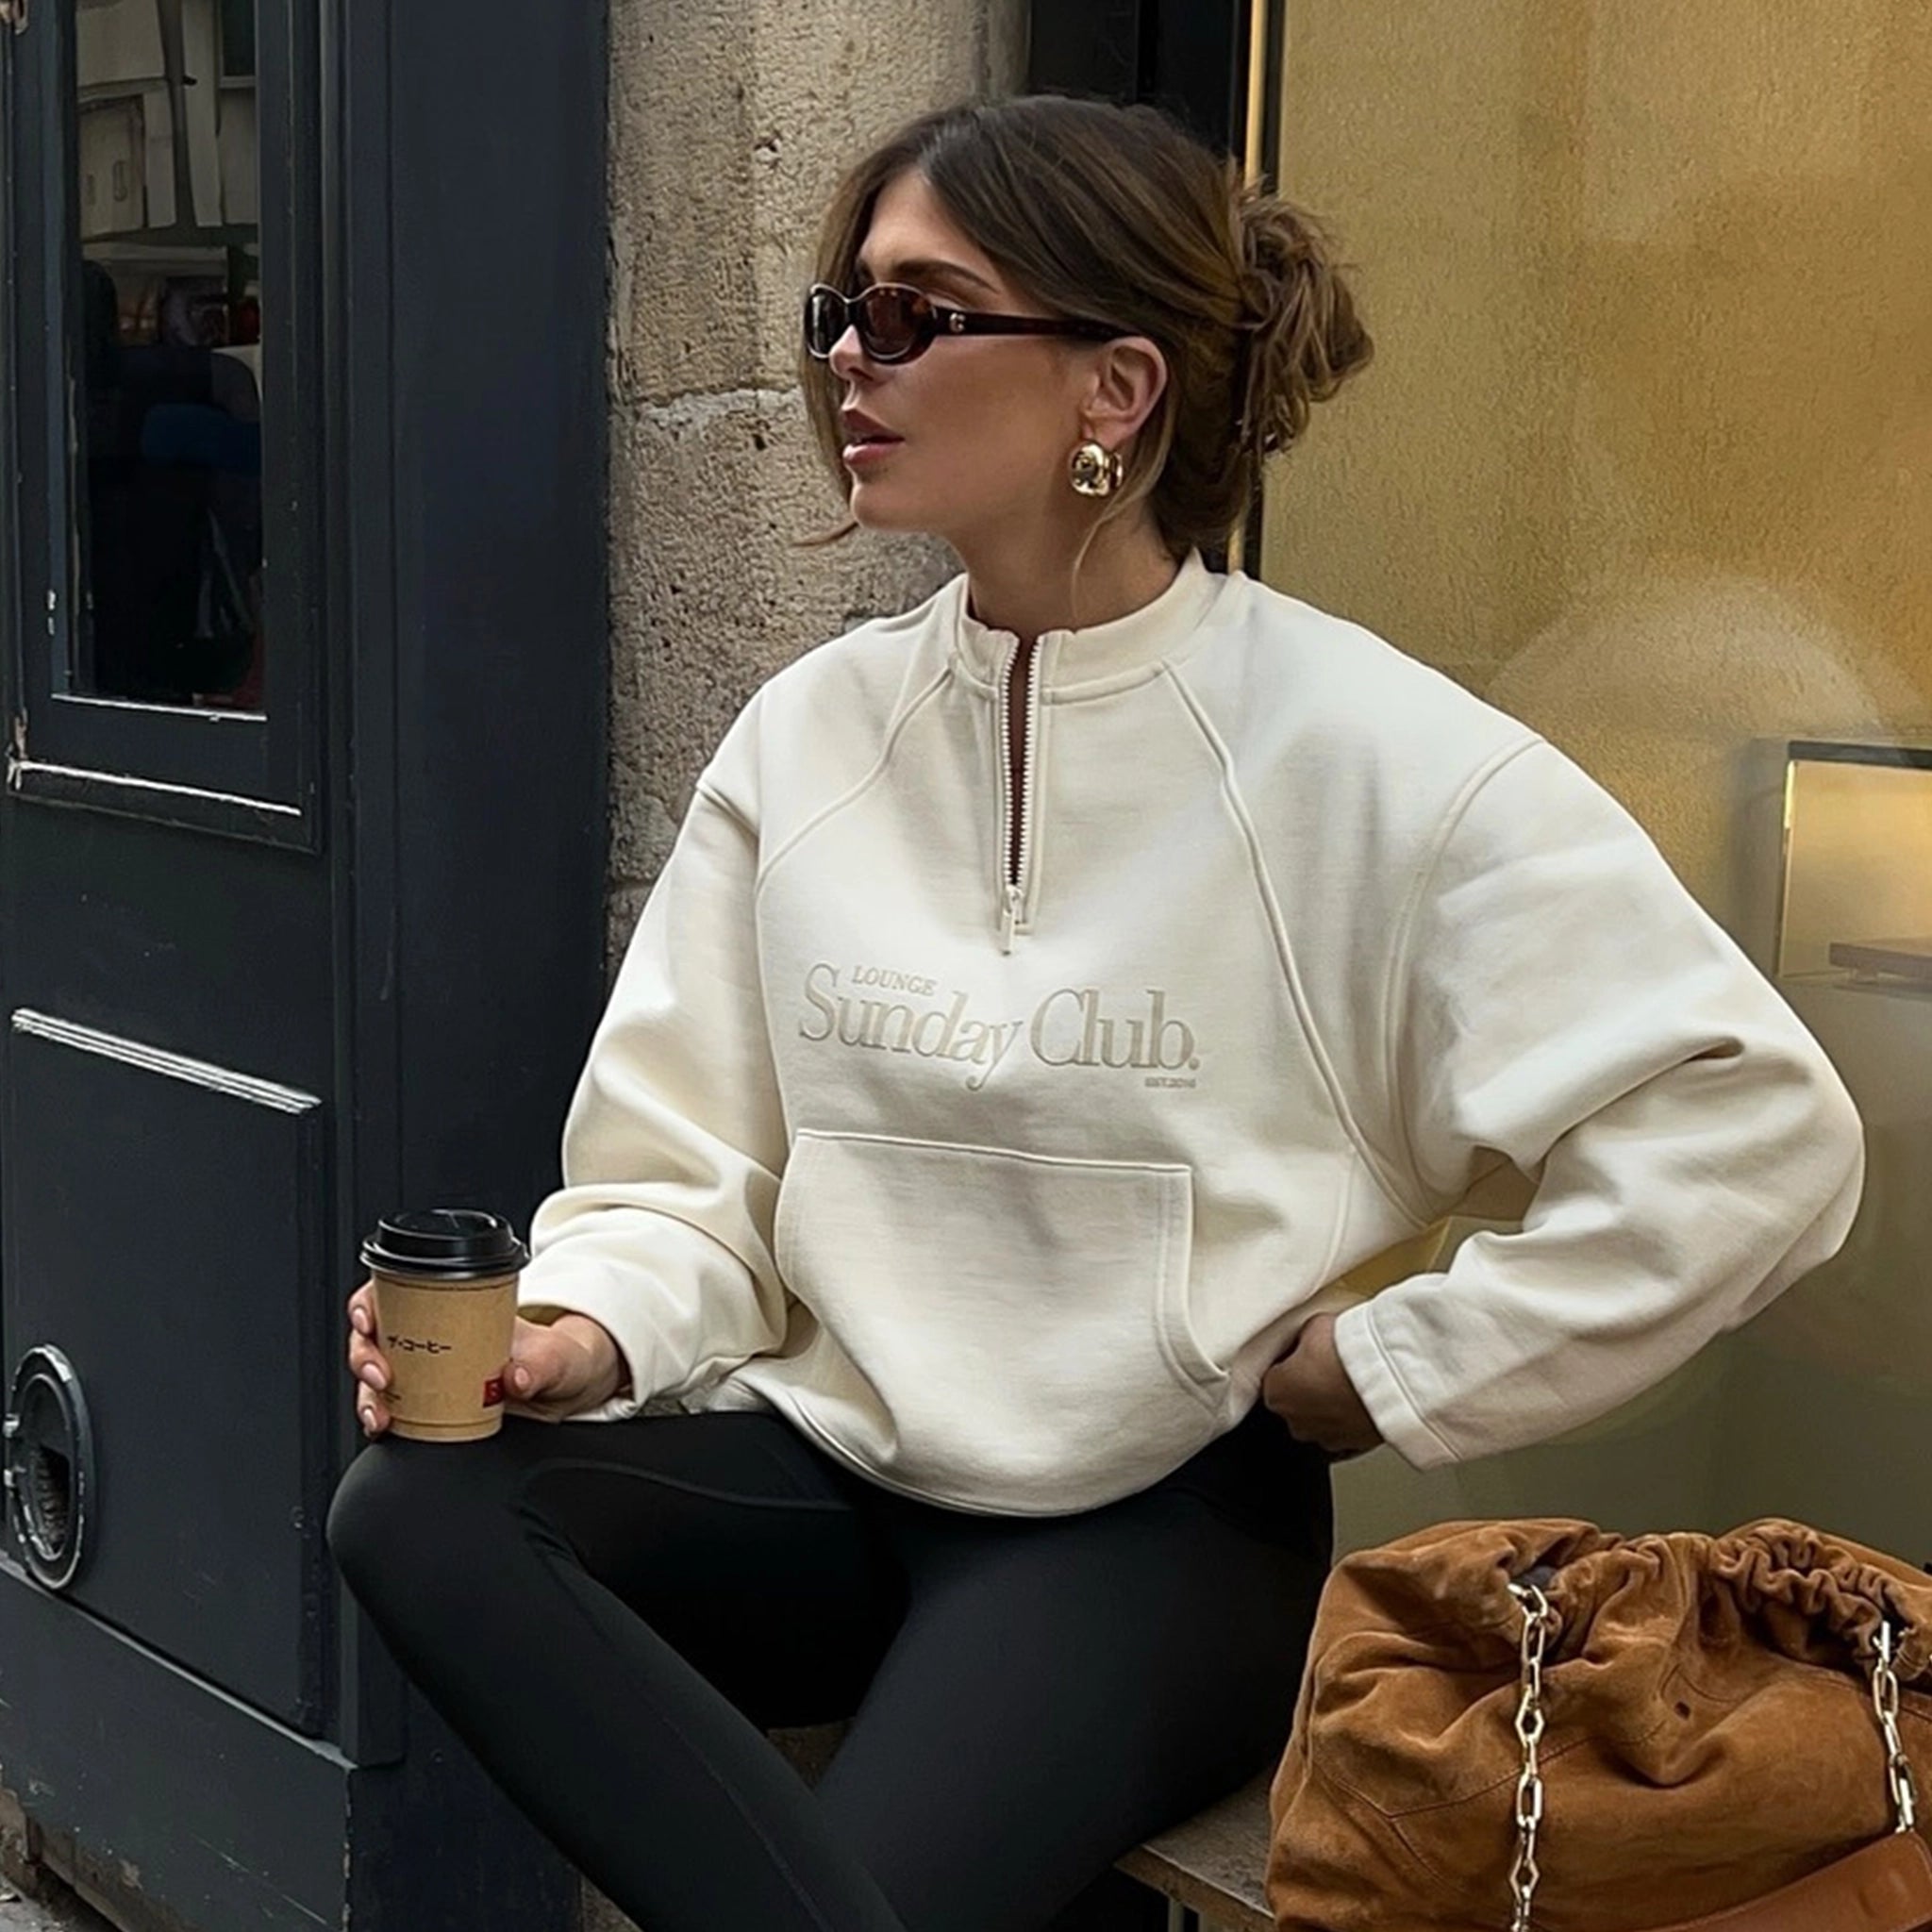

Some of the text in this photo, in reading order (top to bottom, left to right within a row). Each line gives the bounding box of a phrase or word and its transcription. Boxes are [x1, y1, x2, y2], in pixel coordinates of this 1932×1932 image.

[851, 965, 937, 996] LOUNGE
[799, 963, 1200, 1091] Sunday Club.
